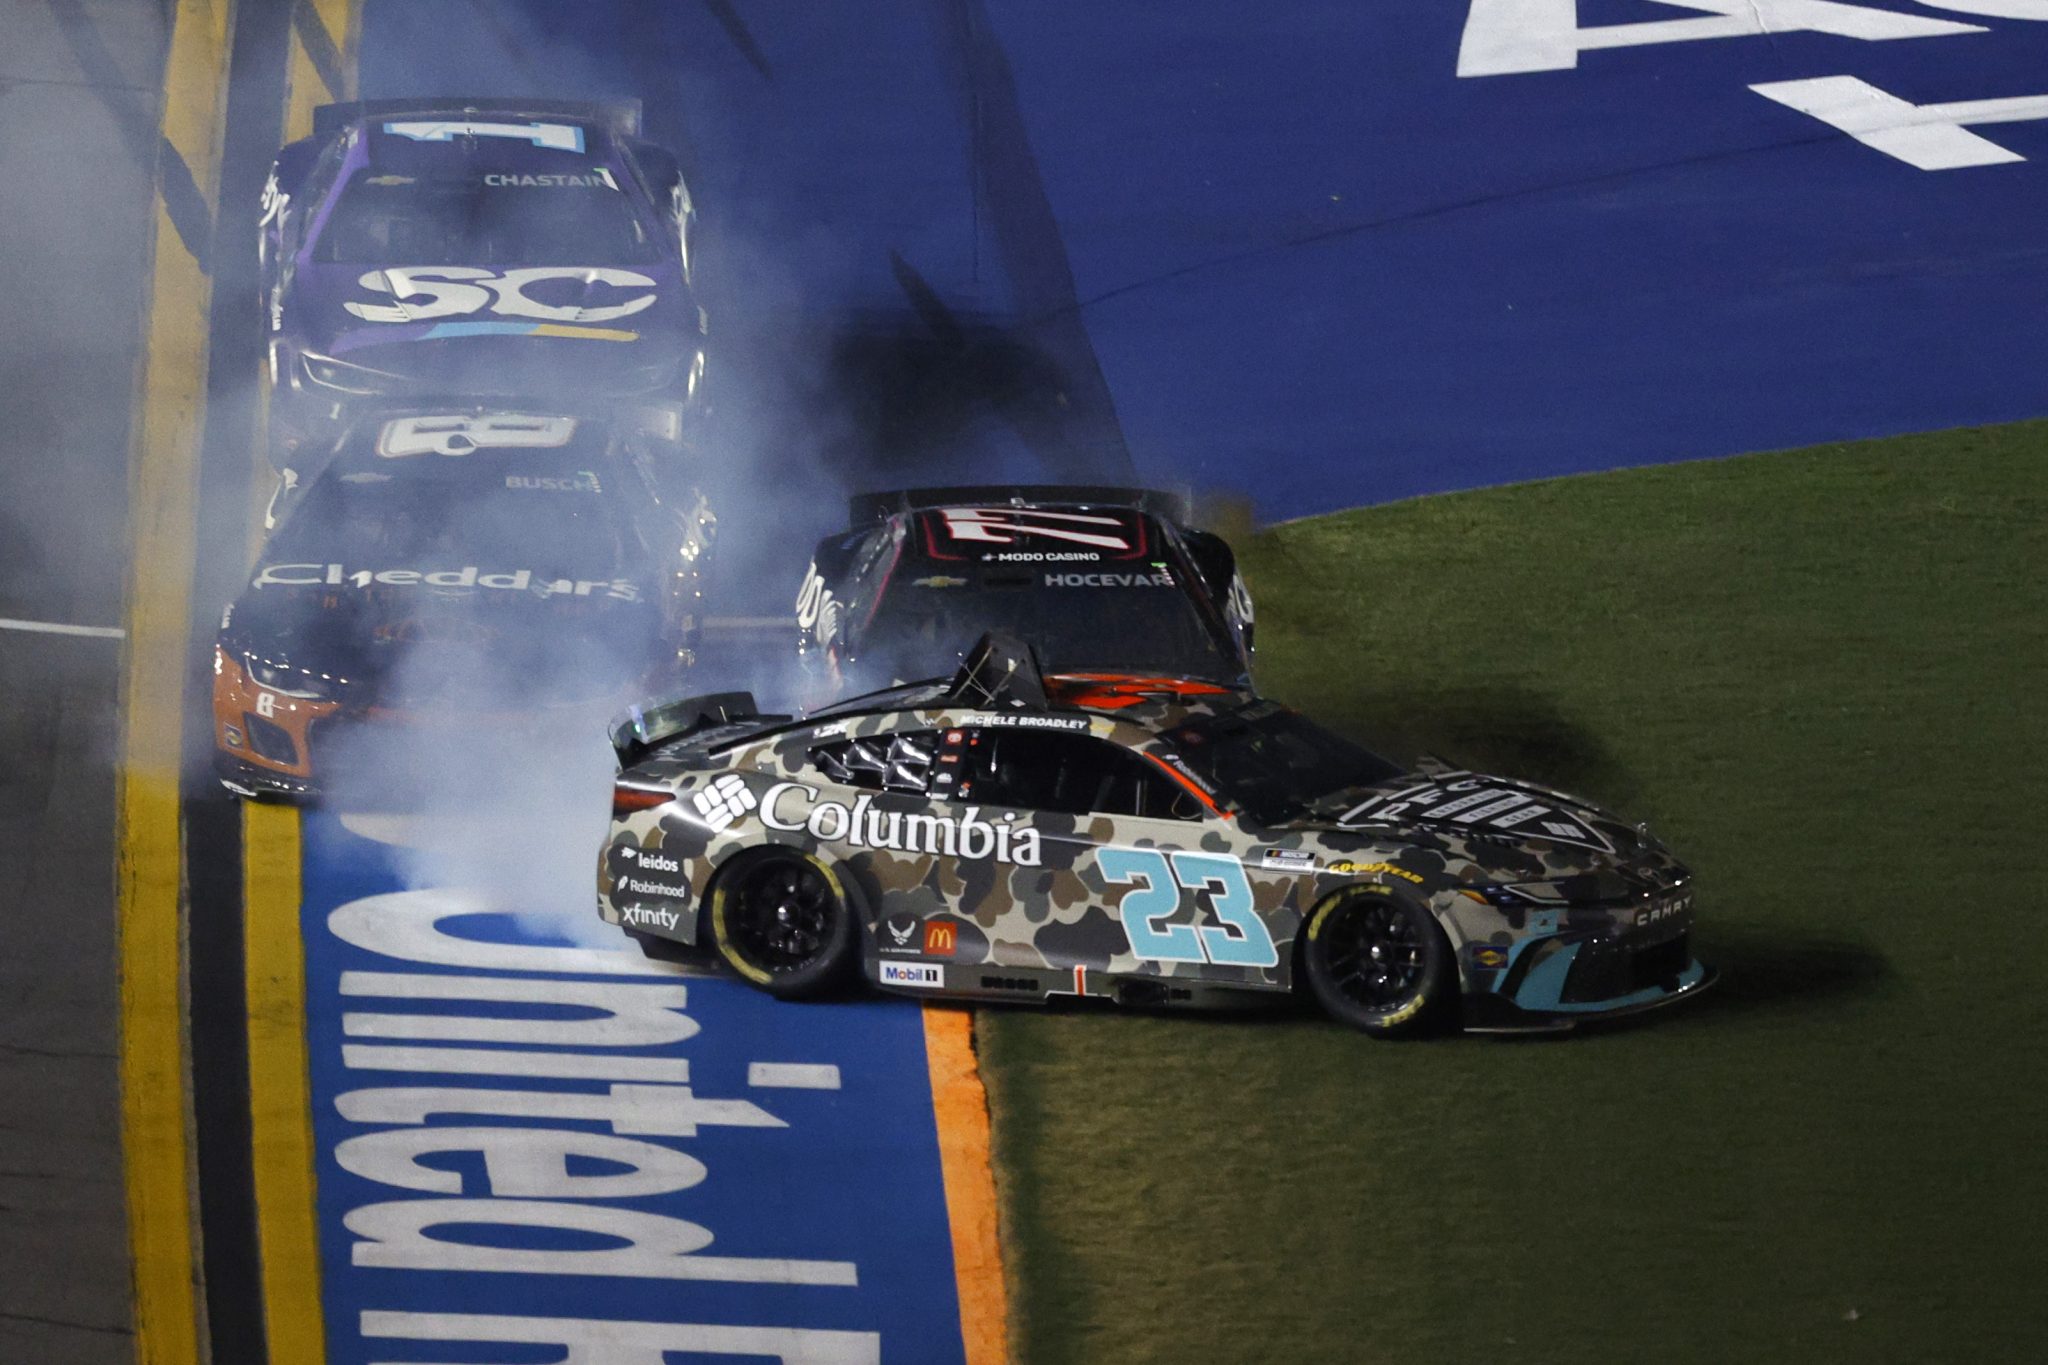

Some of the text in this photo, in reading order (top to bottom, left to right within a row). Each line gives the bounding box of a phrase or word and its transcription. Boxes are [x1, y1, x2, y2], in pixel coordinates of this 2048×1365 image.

[999, 552, 1100, 562] MODO CASINO
[1045, 573, 1174, 588] HOCEVAR
[961, 714, 1088, 730] MICHELE BROADLEY
[758, 782, 1042, 866] Columbia
[638, 852, 679, 872] leidos
[630, 879, 685, 898] Robinhood
[622, 902, 680, 931] xfinity
[1095, 846, 1279, 968] 23
[1637, 895, 1691, 926] CAMRY
[885, 966, 923, 981] Mobil
